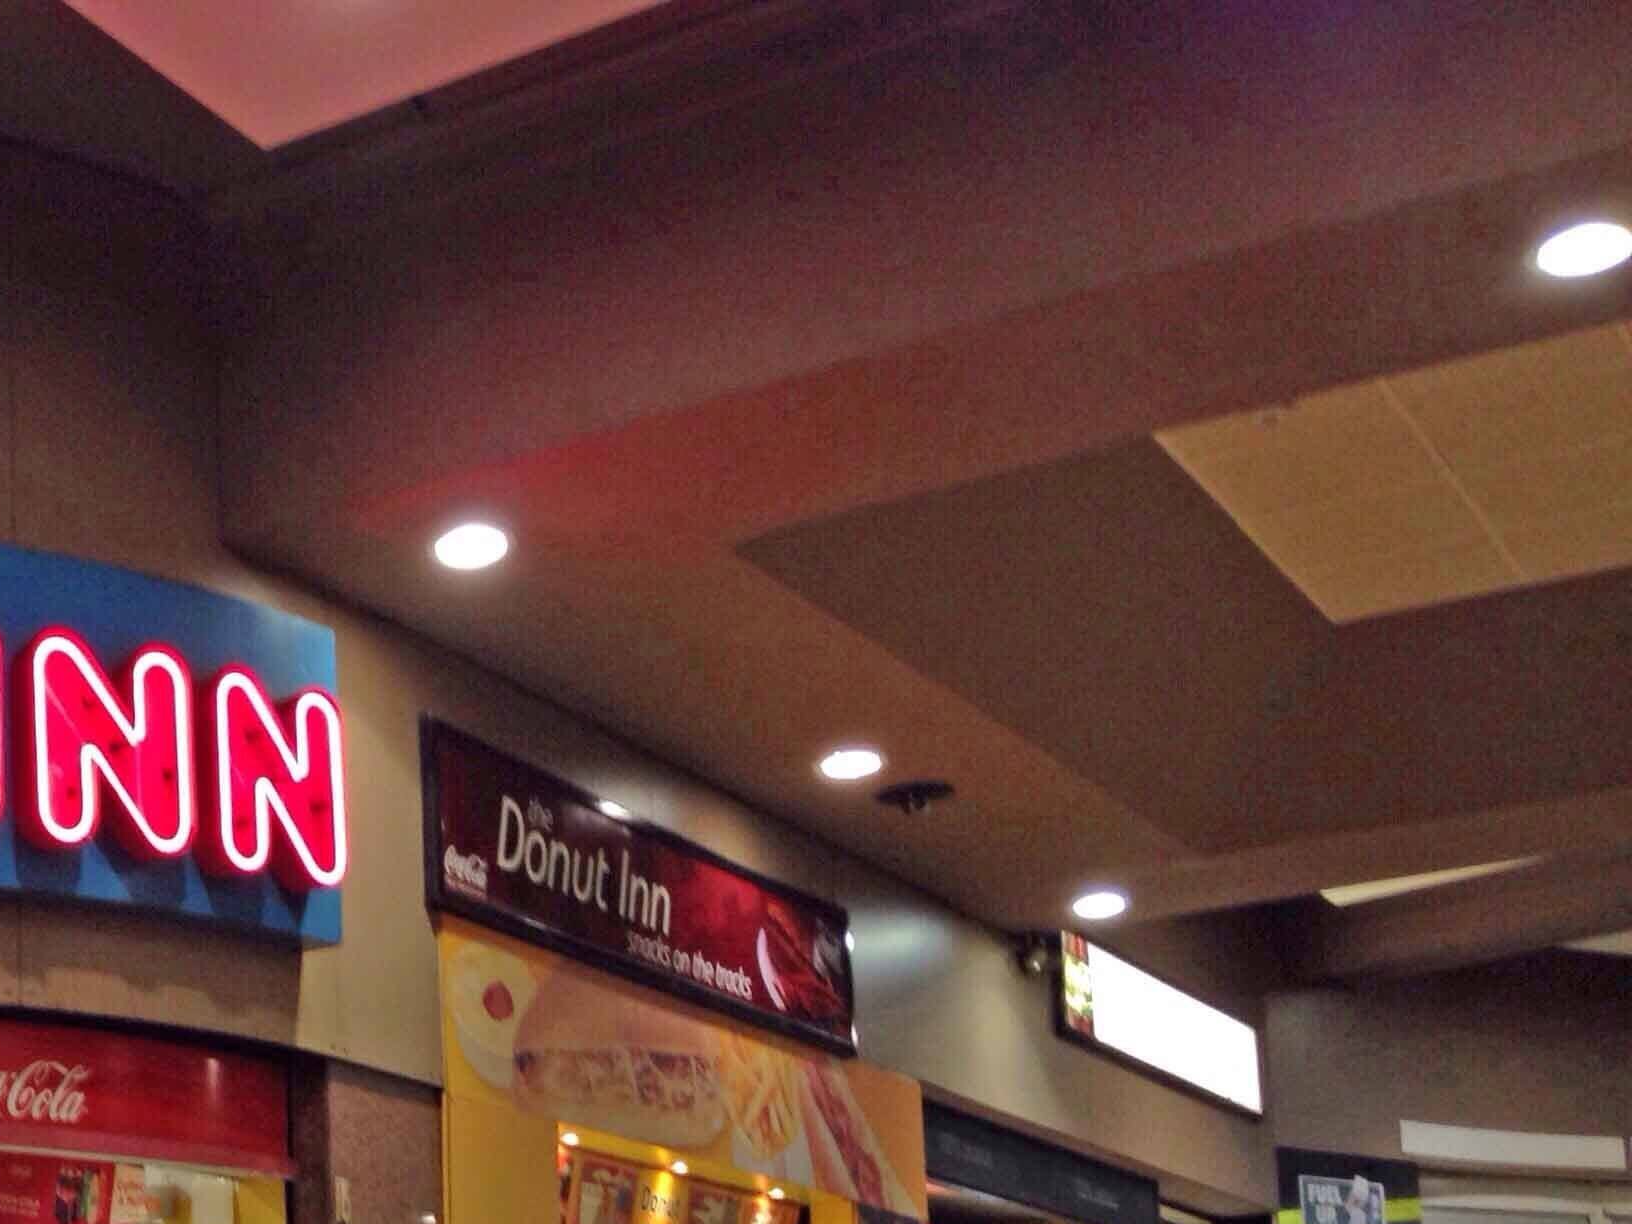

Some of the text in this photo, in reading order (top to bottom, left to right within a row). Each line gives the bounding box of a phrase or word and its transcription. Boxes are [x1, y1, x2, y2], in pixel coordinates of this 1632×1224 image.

[496, 795, 671, 936] Donut Inn
[692, 950, 715, 986] the
